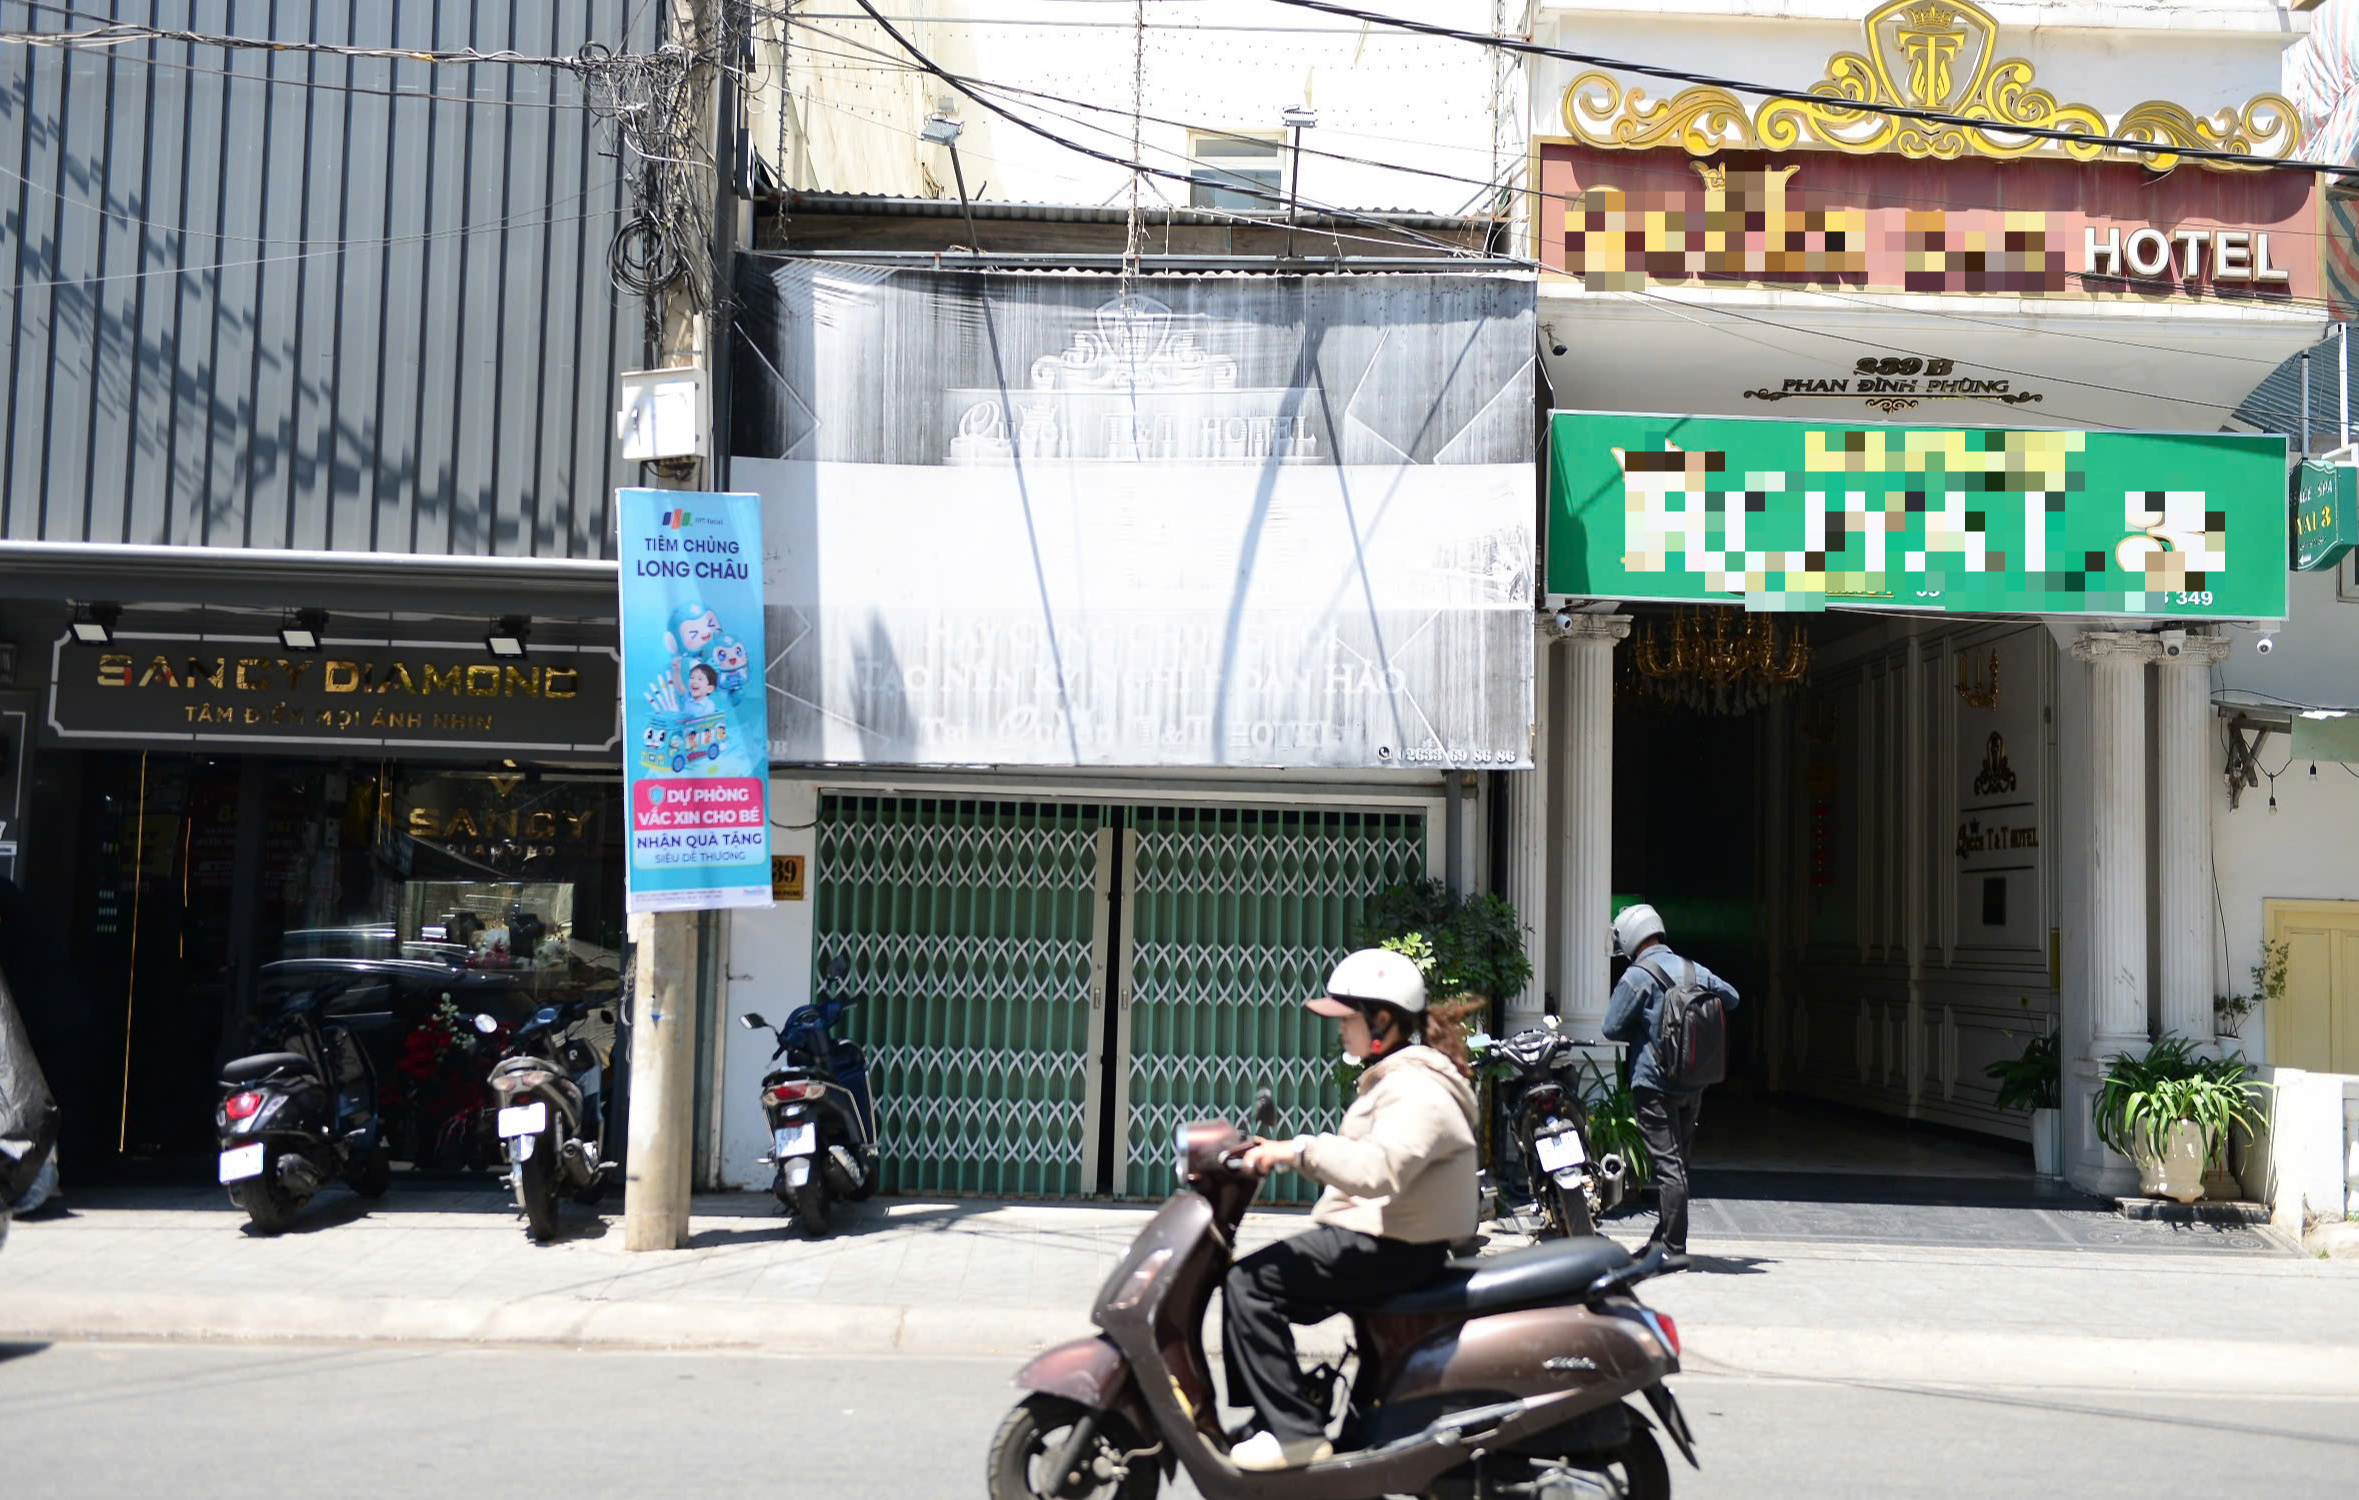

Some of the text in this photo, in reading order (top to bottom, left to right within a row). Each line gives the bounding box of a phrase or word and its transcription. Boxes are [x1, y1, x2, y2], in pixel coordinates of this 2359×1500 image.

[2085, 226, 2290, 283] HOTEL
[1923, 357, 1955, 377] B
[1781, 376, 2010, 394] PHAN ĐÌNH PHÙNG
[2317, 479, 2332, 498] SPA
[2321, 504, 2331, 528] 3
[645, 534, 678, 552] TIÊM
[637, 557, 748, 580] LONG CHÂU
[2176, 591, 2213, 606] 349
[97, 653, 578, 699] SANCY DIAMOND
[185, 702, 233, 723] TÂM
[316, 709, 361, 730] MỌI
[371, 706, 422, 729] ÁNH
[1450, 748, 1468, 762] 69
[1473, 749, 1492, 763] 86
[1496, 749, 1516, 763] 86
[667, 785, 750, 806] DỰ PHÒNG
[409, 807, 595, 840] SANCY
[637, 805, 760, 826] VẮC XIN CHO BÉ
[637, 831, 762, 851] NHẬN QUÀ TẶNG
[2010, 827, 2039, 849] HOTEL
